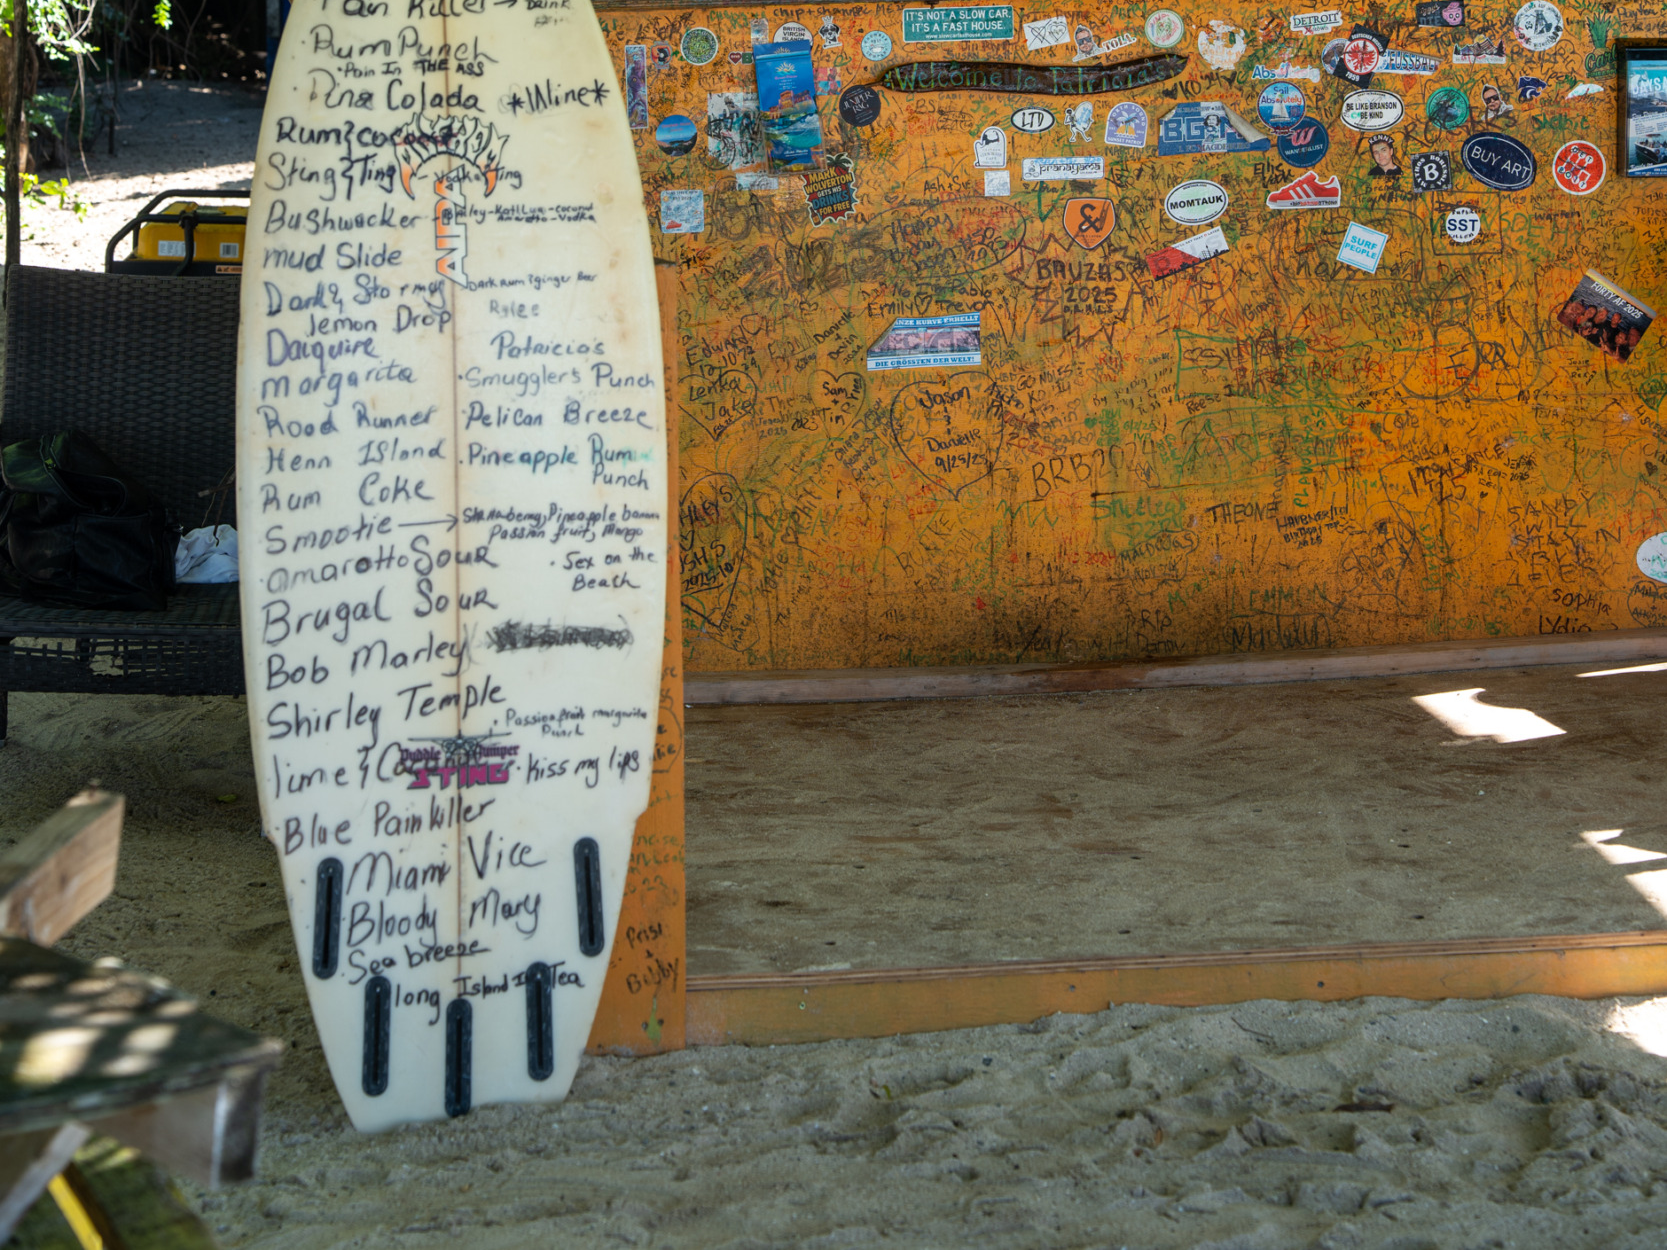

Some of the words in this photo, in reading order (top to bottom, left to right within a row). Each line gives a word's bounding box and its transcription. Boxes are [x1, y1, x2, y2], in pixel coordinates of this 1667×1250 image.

[905, 11, 924, 21] IT'S
[926, 10, 946, 21] NOT
[949, 10, 957, 20] A
[959, 9, 986, 20] SLOW
[988, 8, 1012, 20] CAR.
[1293, 12, 1339, 27] DETROIT
[911, 22, 930, 33] IT'S
[932, 22, 940, 32] A
[942, 21, 968, 32] FAST
[970, 20, 1006, 31] HOUSE.
[310, 23, 392, 61] Rum
[397, 25, 500, 65] Punch
[896, 62, 1004, 92] Welcome
[1016, 65, 1038, 90] to
[385, 79, 487, 114] Colada
[1355, 102, 1368, 110] LIKE
[1369, 101, 1398, 110] BRANSON
[1021, 111, 1045, 129] LTD
[1360, 111, 1368, 119] BE
[1369, 111, 1384, 119] KIND
[276, 116, 342, 146] Rum
[1107, 137, 1127, 145] SUNSET
[1368, 134, 1393, 145] KENNY
[1470, 145, 1501, 166] BUY
[264, 151, 337, 202] Sting
[352, 152, 397, 194] Ting
[808, 166, 838, 184] MARK
[1039, 162, 1102, 176] pranayama
[1423, 162, 1439, 182] B
[1501, 161, 1532, 180] ART
[804, 173, 853, 195] WOLVERTON
[817, 187, 832, 198] GETS
[811, 189, 850, 210] DRINKS
[819, 204, 833, 216] FOR
[833, 200, 851, 212] FREE
[1169, 194, 1224, 211] MOMTAUK
[1447, 218, 1479, 232] SST
[1344, 241, 1377, 261] PEOPLE
[1350, 235, 1379, 251] SURF
[336, 241, 403, 270] Slide
[1590, 280, 1616, 299] FORTY
[1623, 301, 1644, 320] 2025
[391, 303, 452, 335] Drop
[590, 361, 656, 389] Punch
[256, 404, 339, 439] Road
[352, 400, 438, 430] Runner
[563, 399, 655, 431] Breeze
[592, 461, 649, 491] Punch
[260, 482, 322, 514] Rum
[358, 470, 436, 507] Coke
[562, 550, 596, 571] Sex
[604, 553, 623, 566] on
[628, 545, 659, 564] the
[570, 571, 642, 593] Beach
[265, 652, 330, 692] Bob
[396, 674, 508, 722] Temple
[284, 812, 353, 856] Blue
[345, 850, 452, 898] Miami
[467, 830, 548, 881] Vice
[346, 893, 438, 949] Bloody
[469, 886, 542, 940] Mary
[547, 960, 587, 989] Tea
